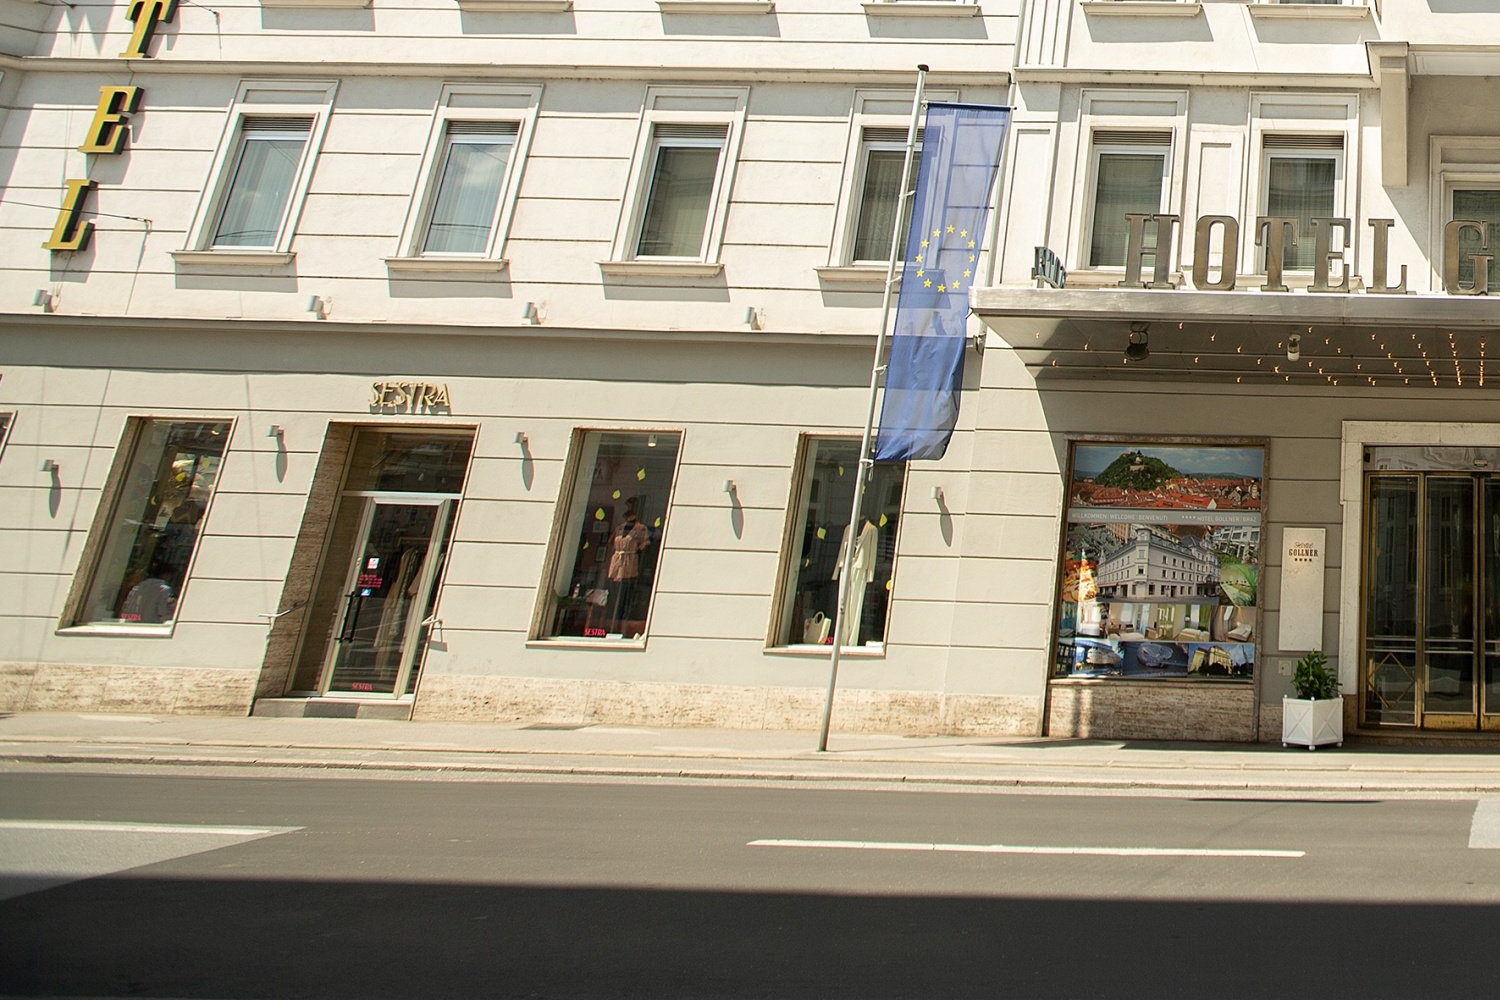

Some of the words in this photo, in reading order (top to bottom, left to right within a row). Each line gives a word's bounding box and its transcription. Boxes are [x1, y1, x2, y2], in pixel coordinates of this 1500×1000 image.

[1117, 213, 1409, 294] HOTEL
[368, 382, 450, 407] SESTRA
[1109, 512, 1135, 520] WELCOME
[1288, 549, 1319, 557] GOLLNER
